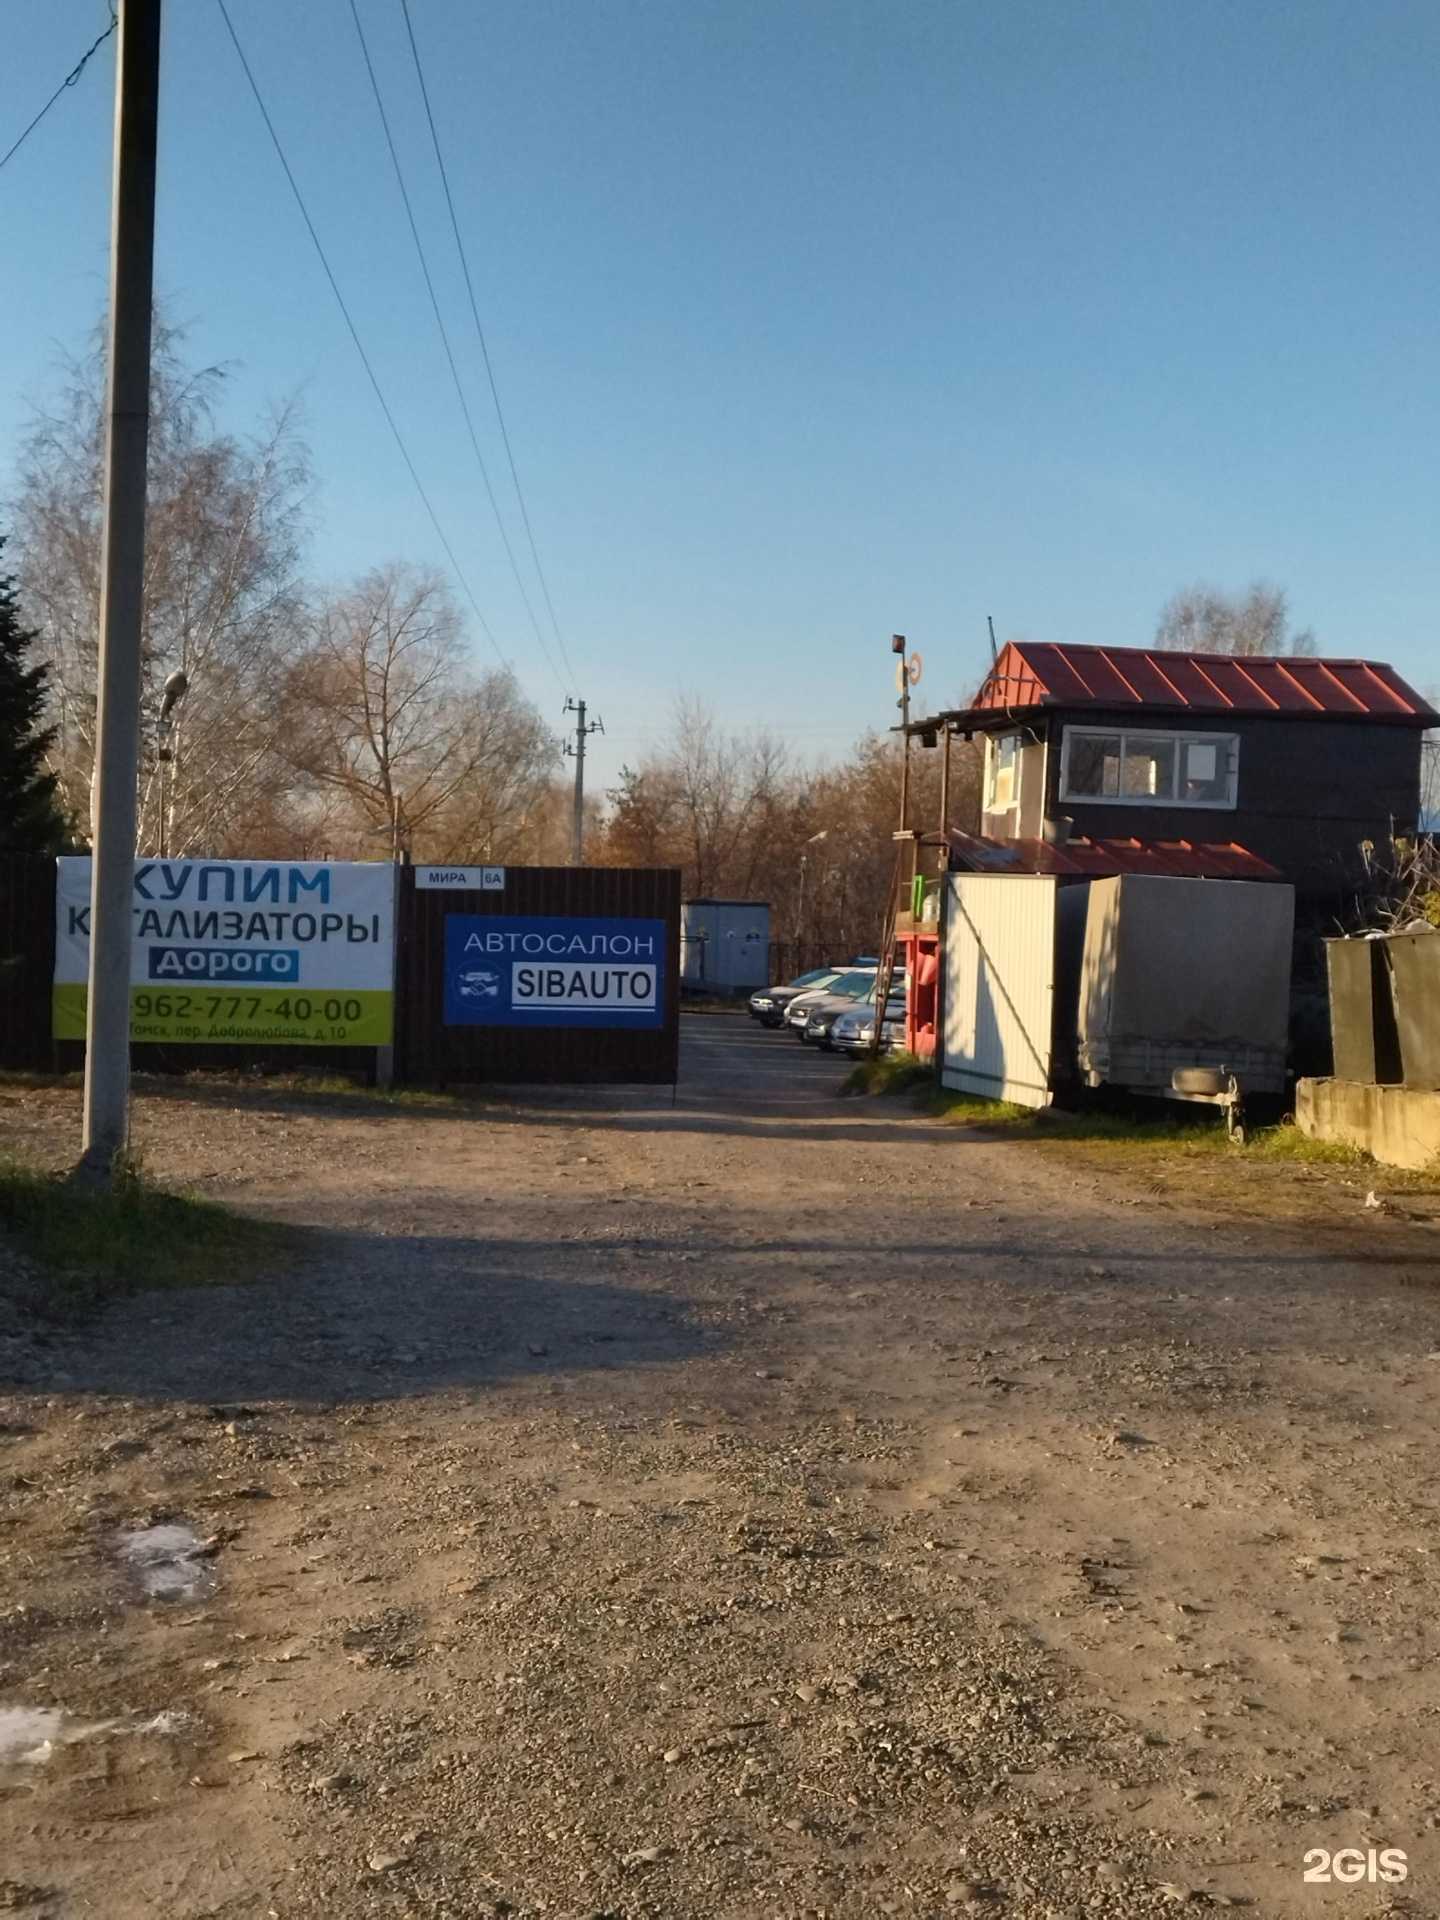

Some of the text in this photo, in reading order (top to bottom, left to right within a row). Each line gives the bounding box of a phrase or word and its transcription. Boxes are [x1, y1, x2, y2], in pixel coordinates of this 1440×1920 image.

[133, 864, 330, 904] КУПИМ
[428, 872, 467, 884] МИРА
[68, 905, 380, 943] КАЛИЗАТОРЫ
[464, 933, 653, 955] АВТОСАЛОН
[517, 969, 651, 999] SIBAUTO
